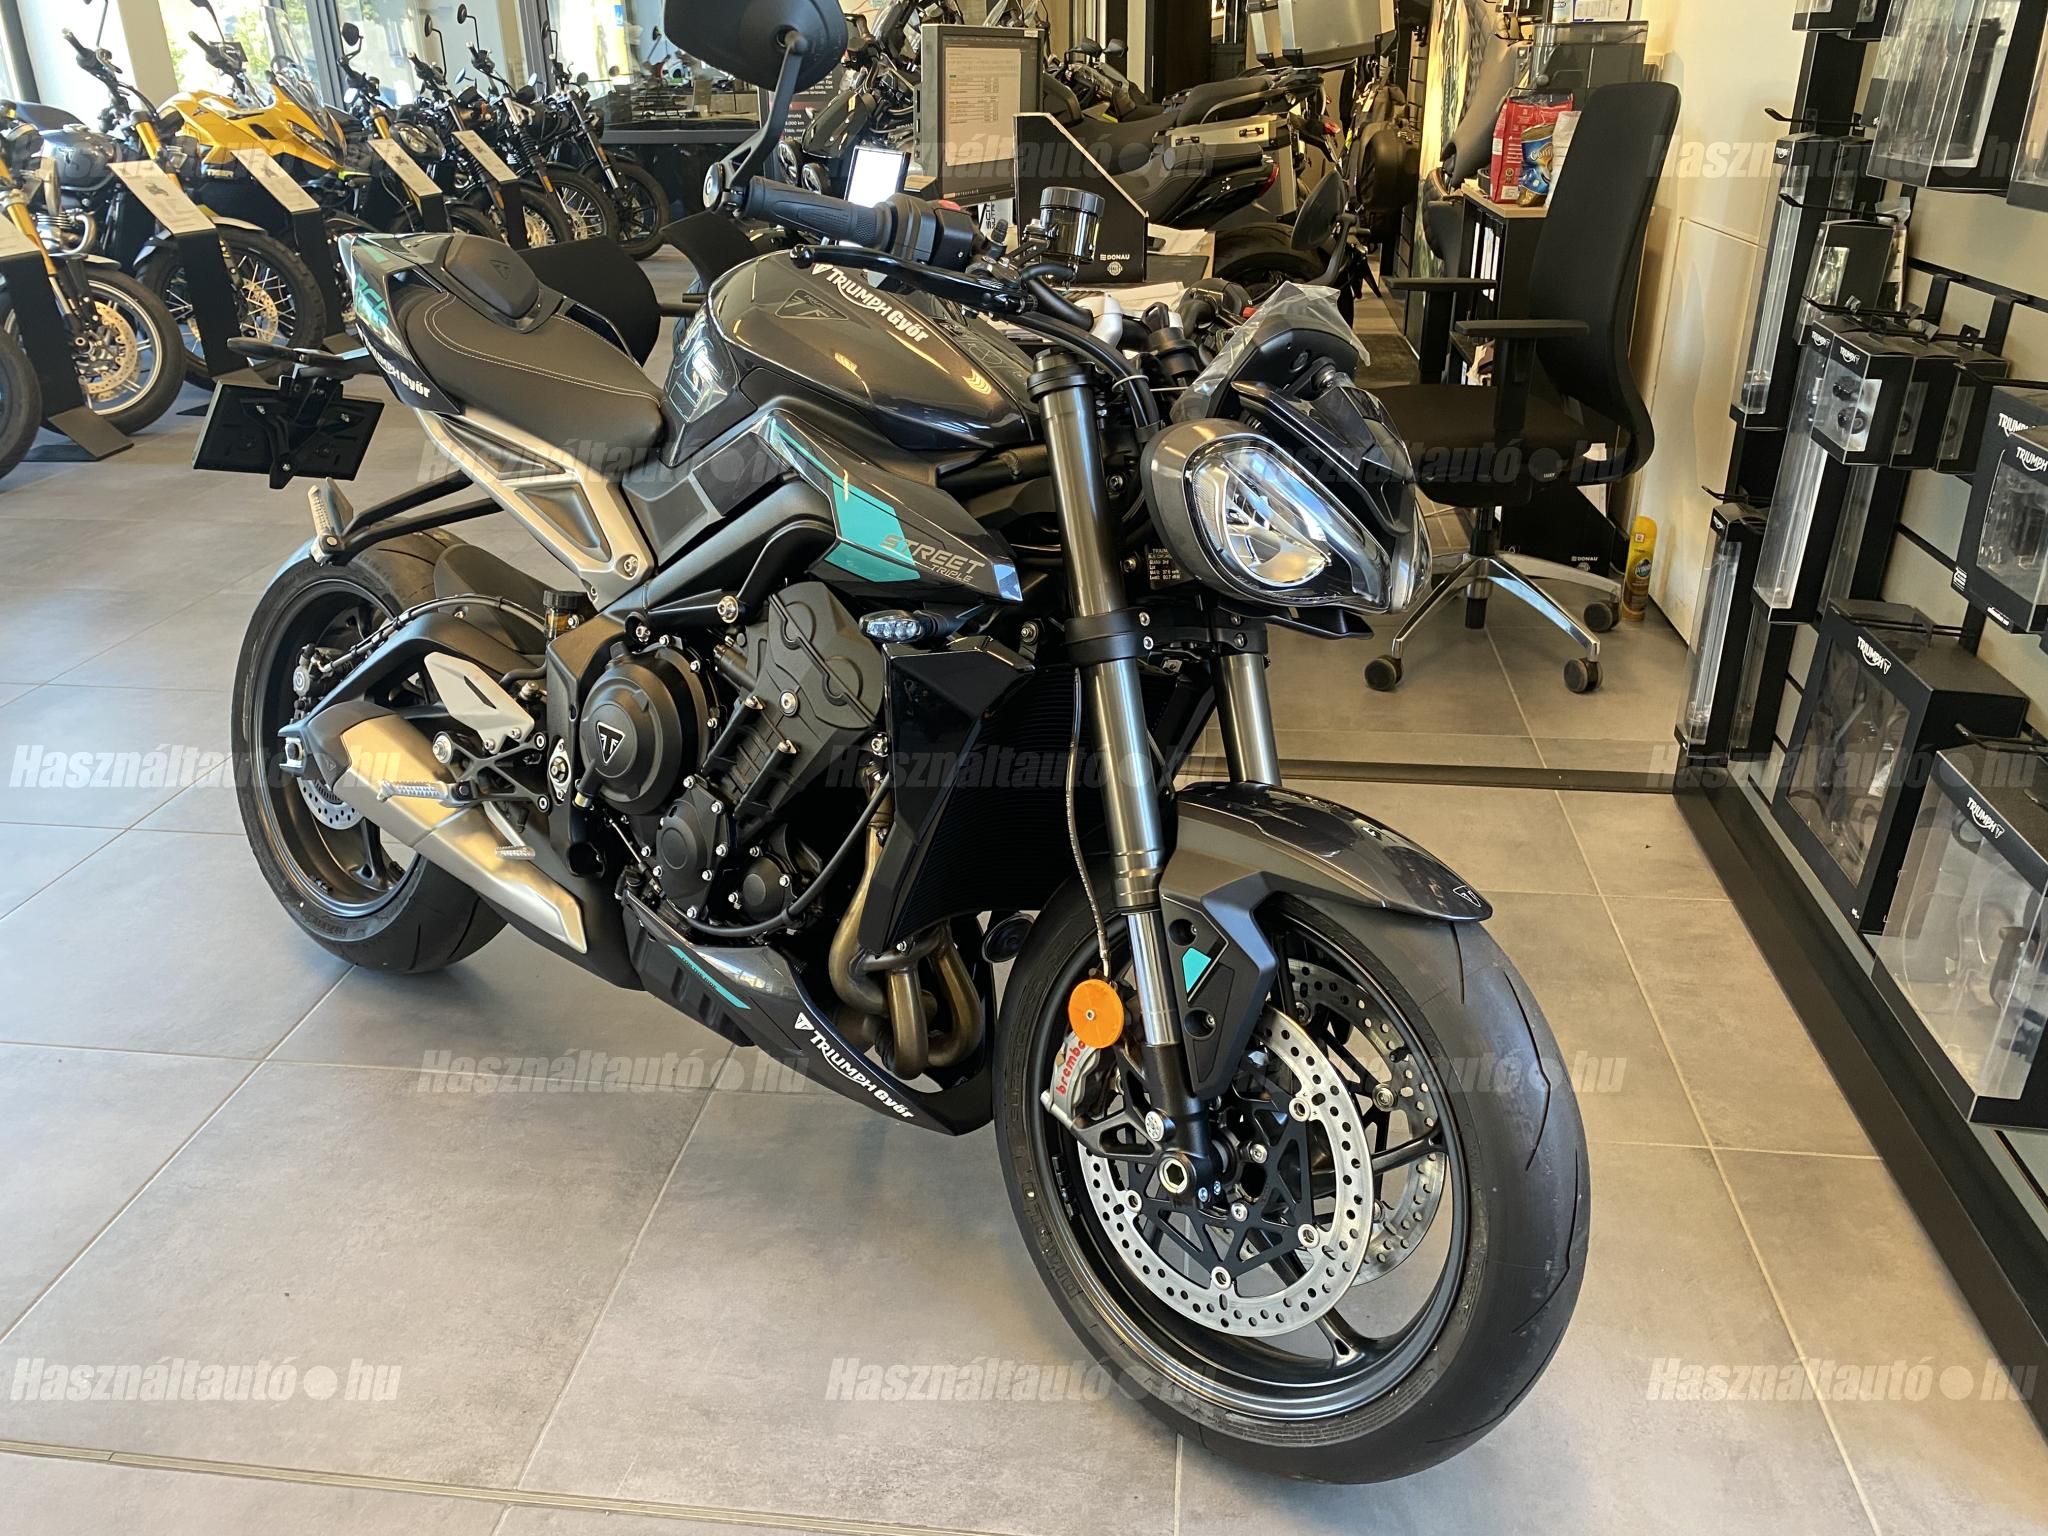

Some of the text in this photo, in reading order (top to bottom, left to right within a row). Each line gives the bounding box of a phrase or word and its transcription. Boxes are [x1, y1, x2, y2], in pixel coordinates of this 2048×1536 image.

[826, 267, 929, 342] TRIUMPH Győr
[880, 535, 986, 574] STREET
[931, 564, 974, 584] TRIPLE
[1967, 796, 1996, 833] TRIUMPH
[810, 1030, 914, 1118] TRIUMPH Győr
[1056, 1040, 1086, 1095] brembo
